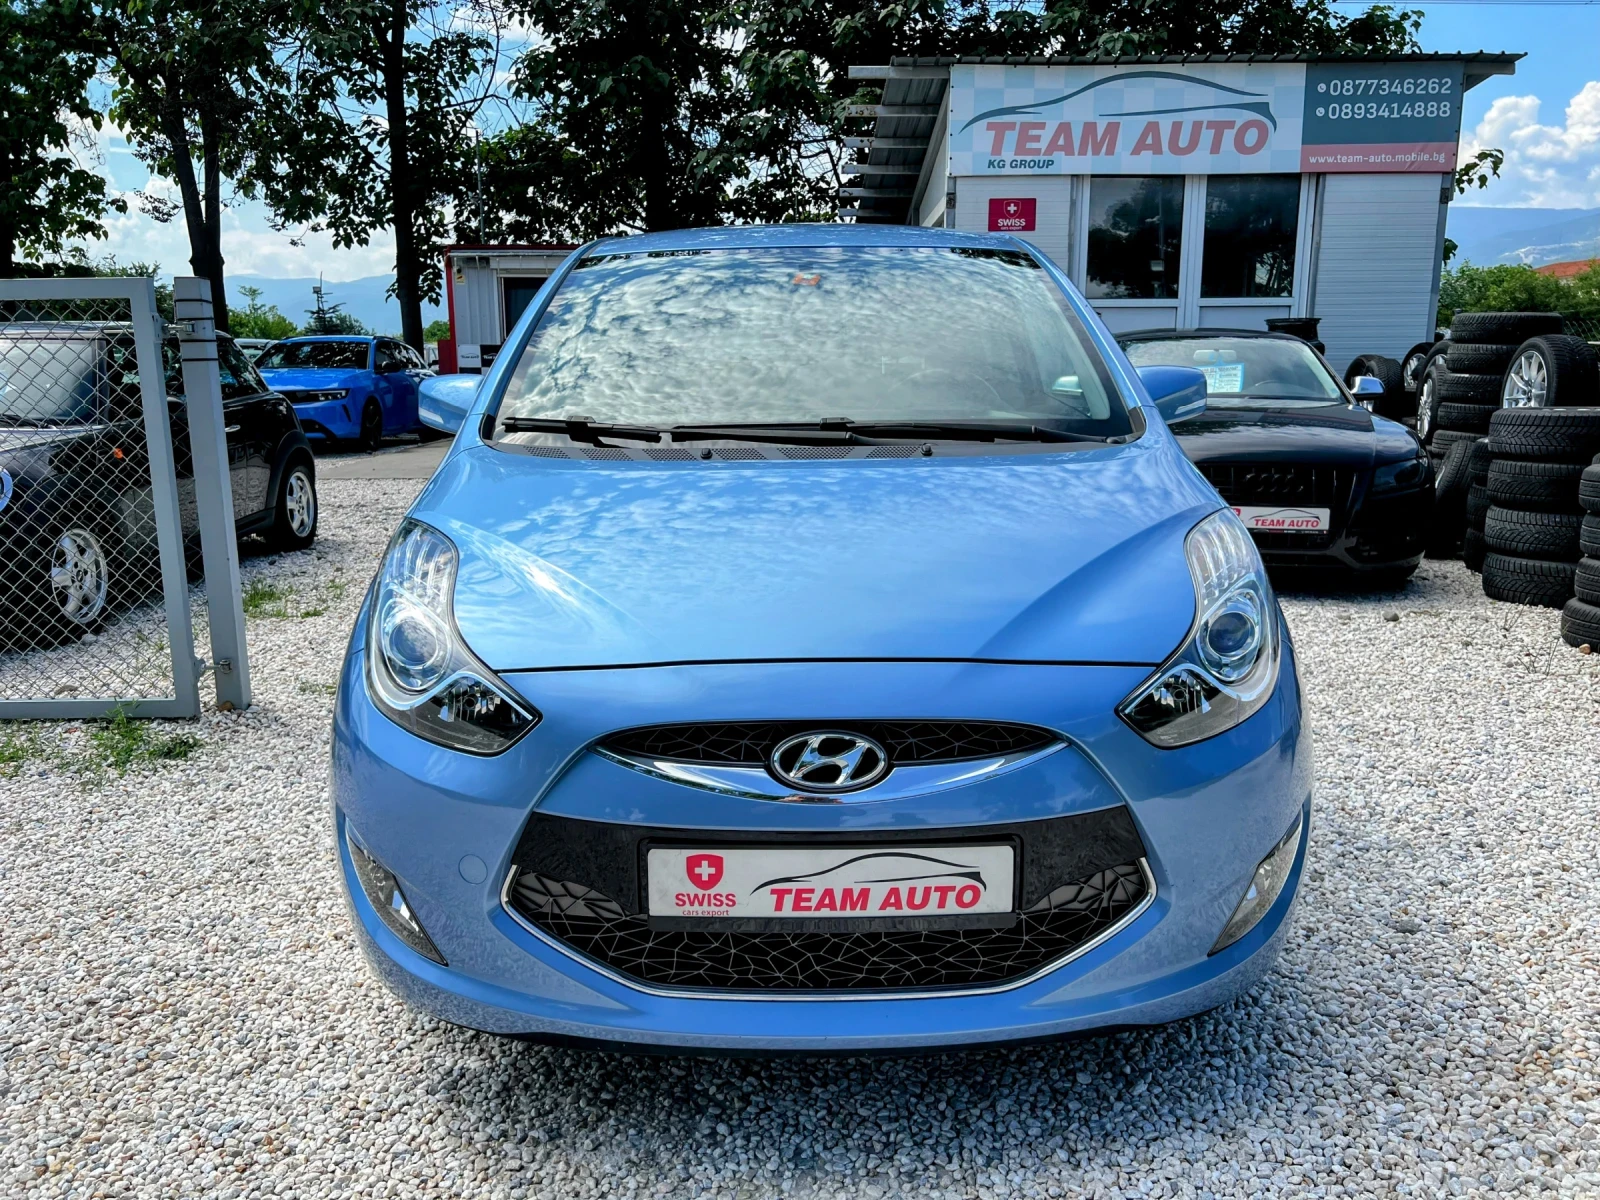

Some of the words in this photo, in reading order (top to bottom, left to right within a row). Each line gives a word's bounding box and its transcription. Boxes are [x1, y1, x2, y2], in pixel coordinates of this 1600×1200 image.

[1329, 78, 1452, 96] 0877346262
[1328, 101, 1451, 119] 0893414888
[985, 121, 1120, 156] TEAM
[1130, 119, 1269, 156] AUTO
[1309, 152, 1445, 163] www.team-auto.mobile.bg
[987, 159, 1006, 169] KG
[1009, 159, 1055, 169] GROUP
[997, 218, 1026, 227] SWISS
[1254, 519, 1285, 527] TEAM
[1288, 519, 1320, 528] AUTO
[675, 893, 737, 907] SWISS
[769, 887, 870, 912] TEAM
[878, 885, 982, 911] AUTO
[701, 909, 730, 917] export
